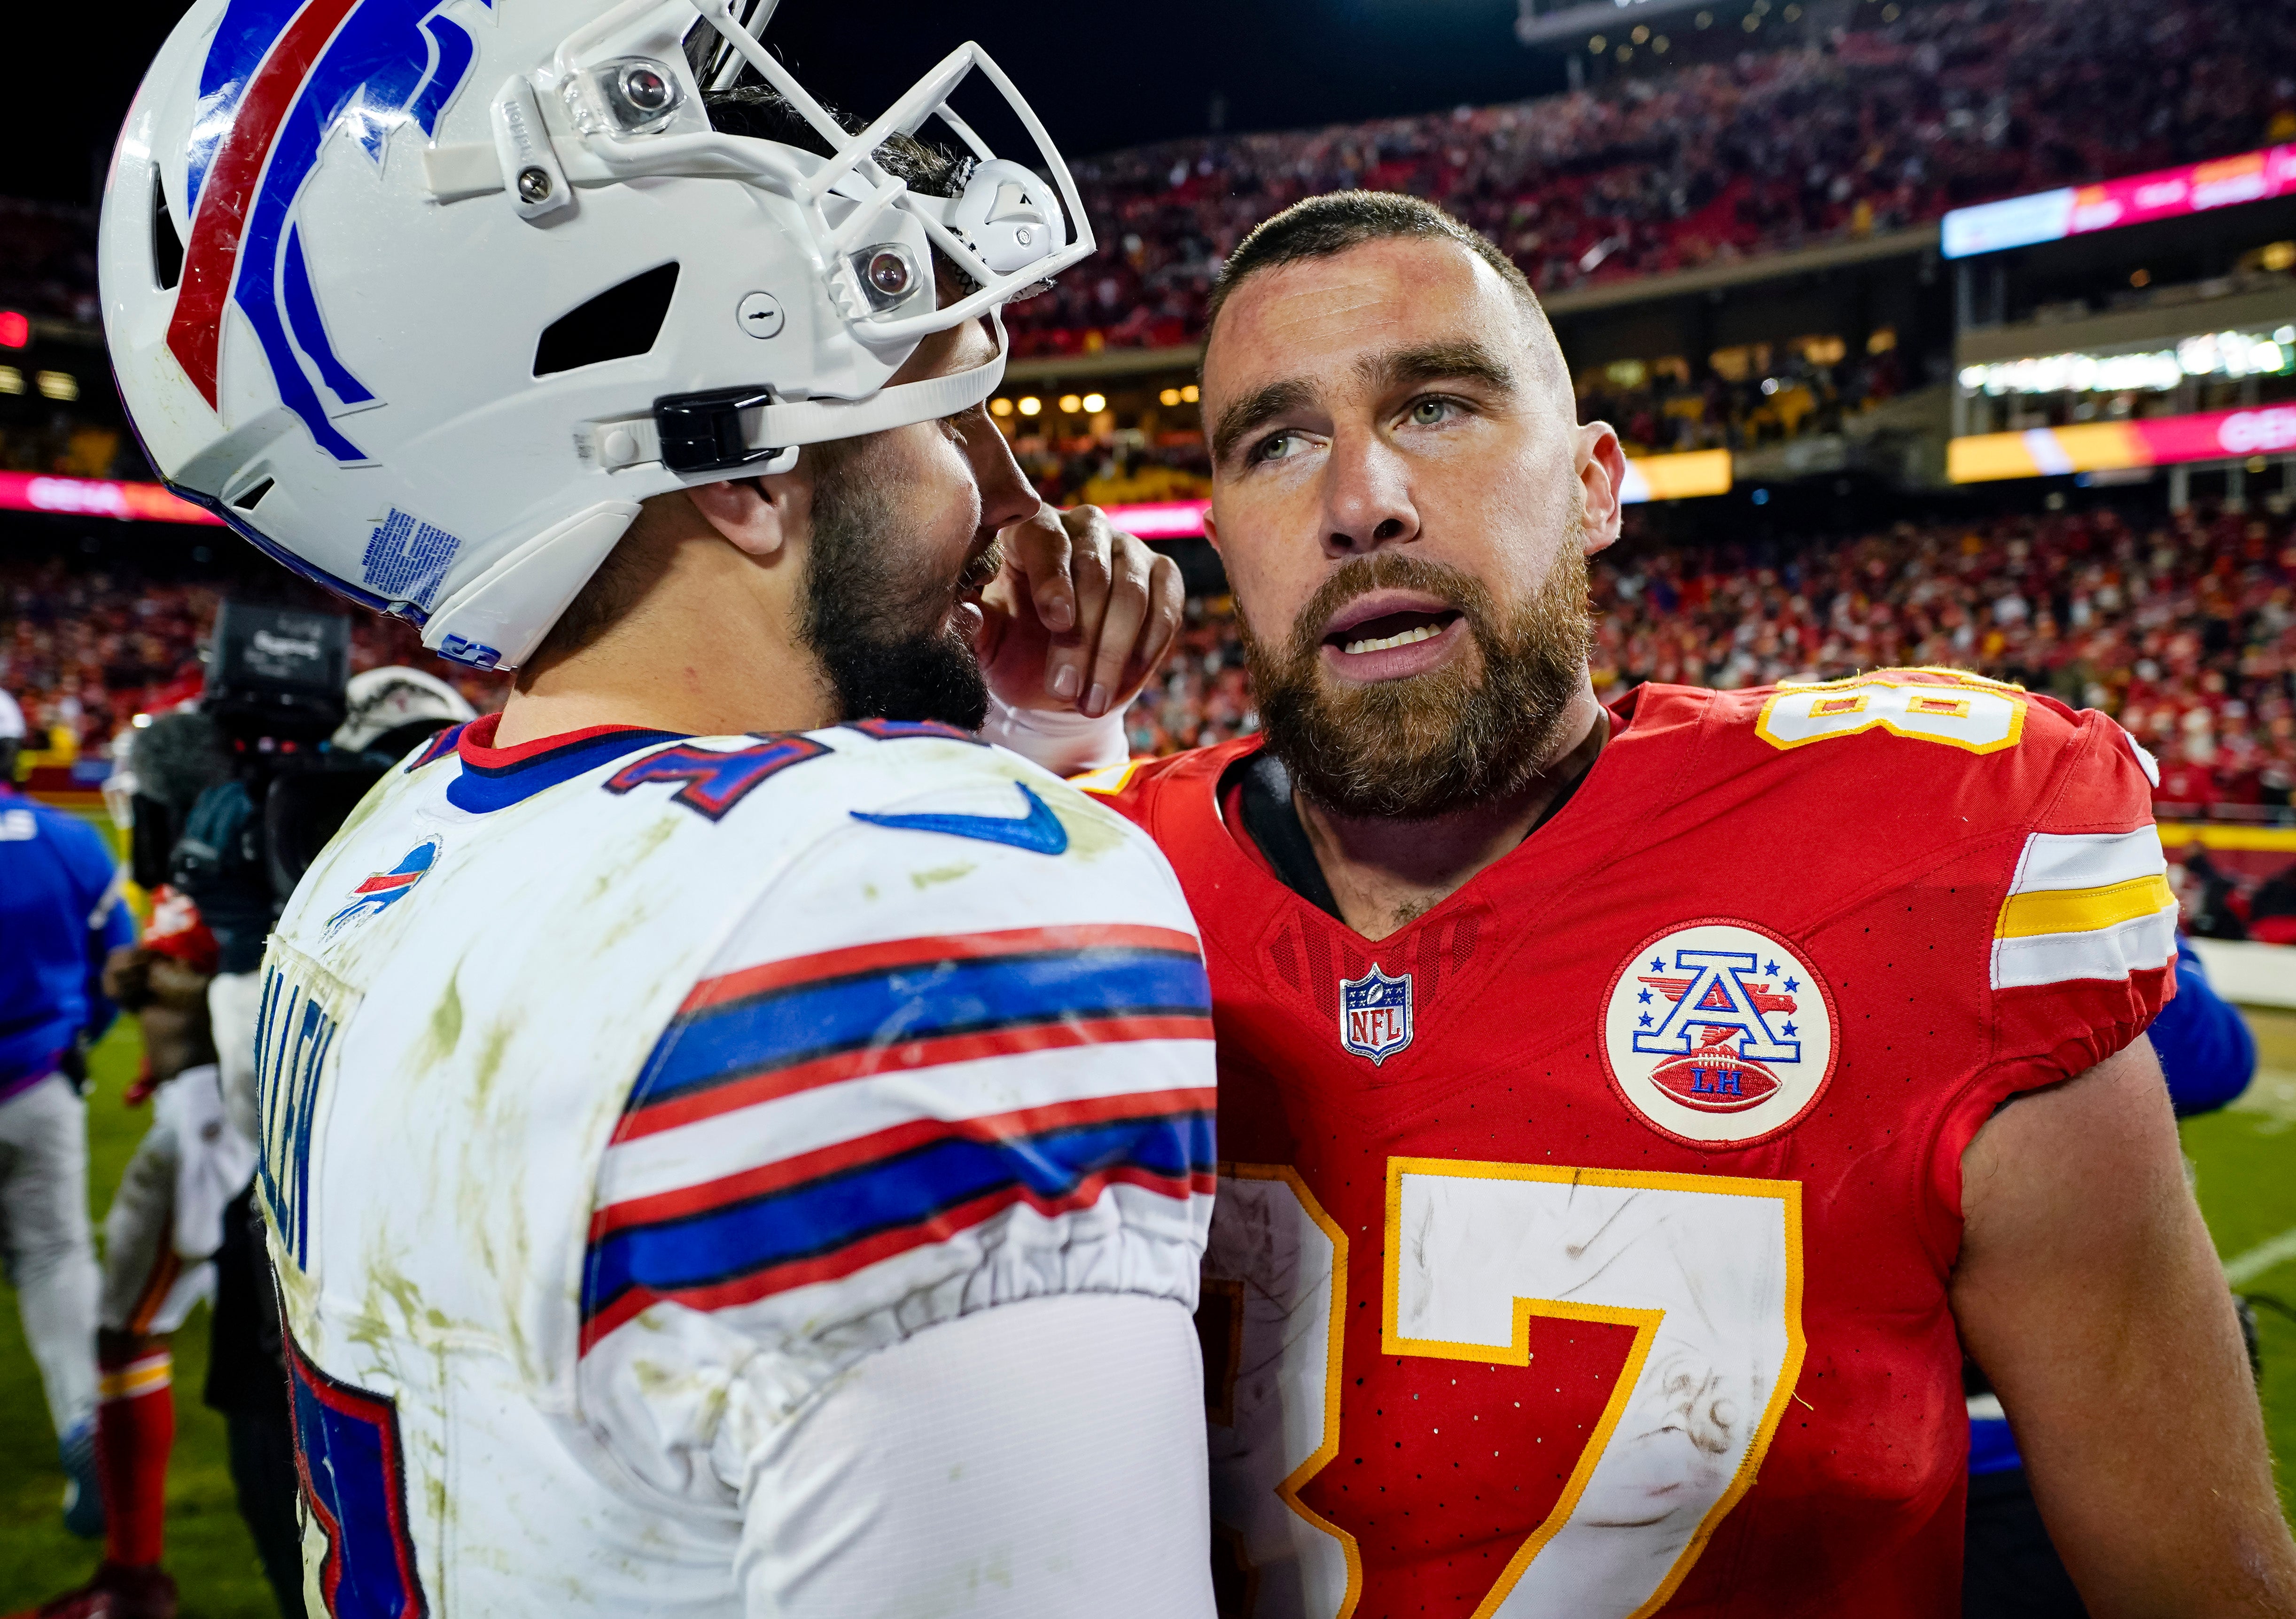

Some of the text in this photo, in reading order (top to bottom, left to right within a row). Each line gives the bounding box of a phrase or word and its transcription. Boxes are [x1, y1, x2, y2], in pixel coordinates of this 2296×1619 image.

[1351, 1008, 1401, 1046] NFL
[1632, 950, 1801, 1063] A
[1691, 1067, 1743, 1096] LH
[255, 965, 338, 1275] LLEN
